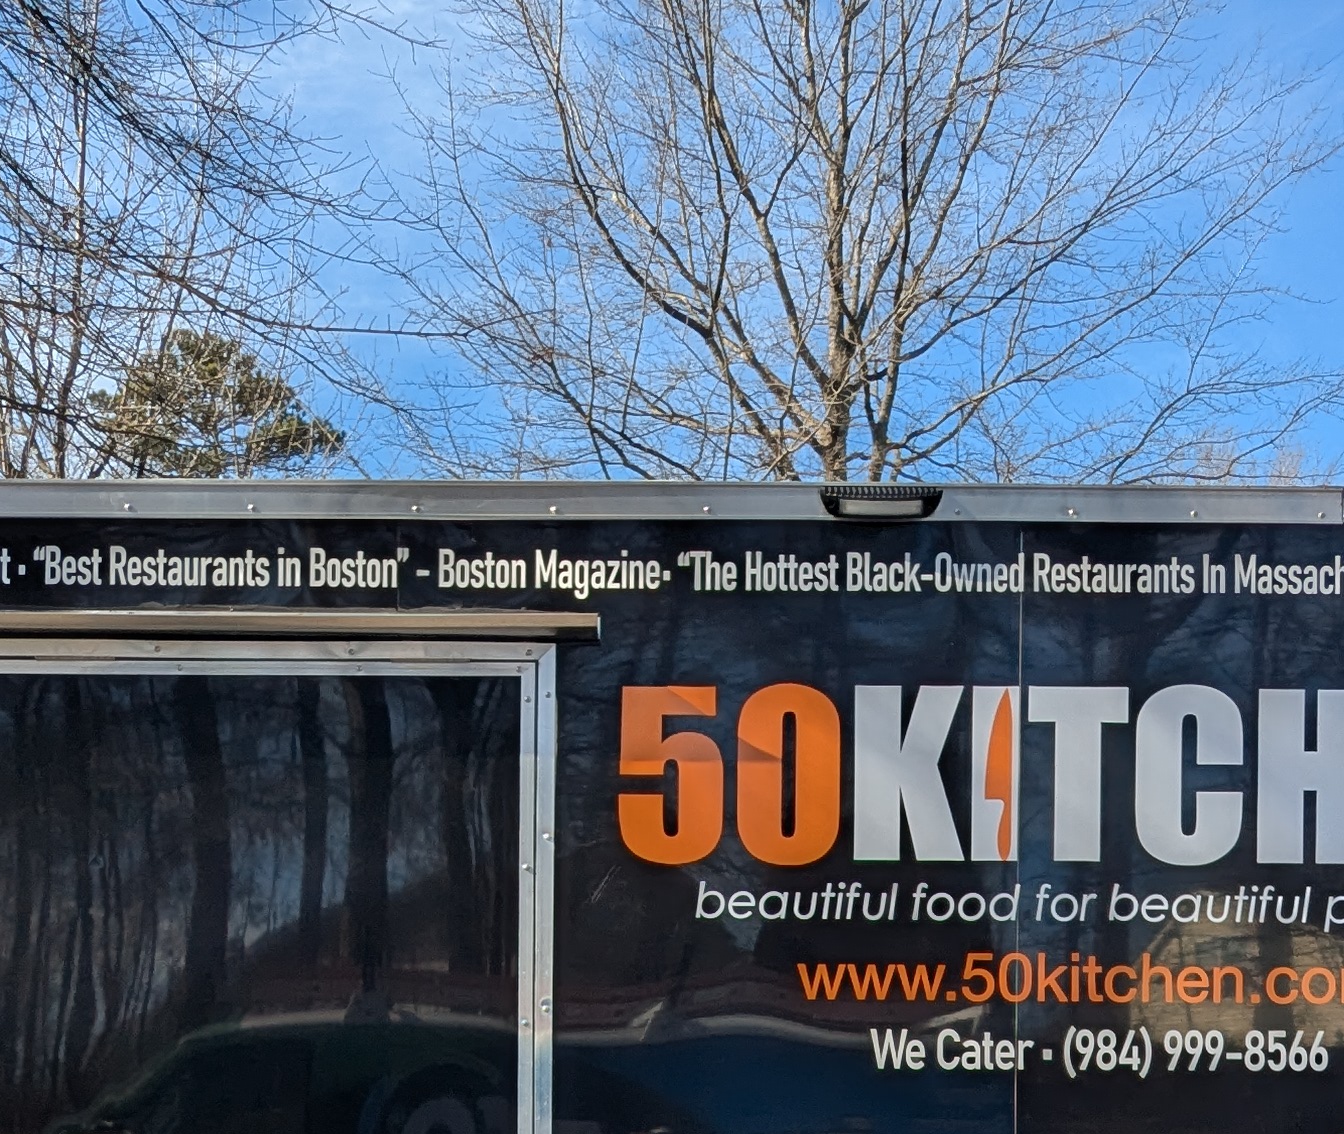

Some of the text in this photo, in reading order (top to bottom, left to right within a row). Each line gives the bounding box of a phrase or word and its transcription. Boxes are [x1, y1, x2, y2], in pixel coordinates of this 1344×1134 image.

[109, 545, 270, 586] Restaurants
[277, 547, 301, 586] in
[438, 548, 527, 588] Boston
[745, 550, 839, 591] Hottest
[846, 551, 1025, 592] Black-Owned
[1033, 552, 1195, 593] Restaurants
[1202, 553, 1226, 593] In
[695, 880, 899, 922] beautiful
[911, 882, 1022, 923] food
[1035, 883, 1098, 923] for
[1108, 884, 1312, 925] beautiful
[869, 1028, 927, 1070] We
[936, 1028, 1035, 1072] Cater
[1063, 1025, 1153, 1079] (984)
[1163, 1029, 1329, 1073] 999-8566
